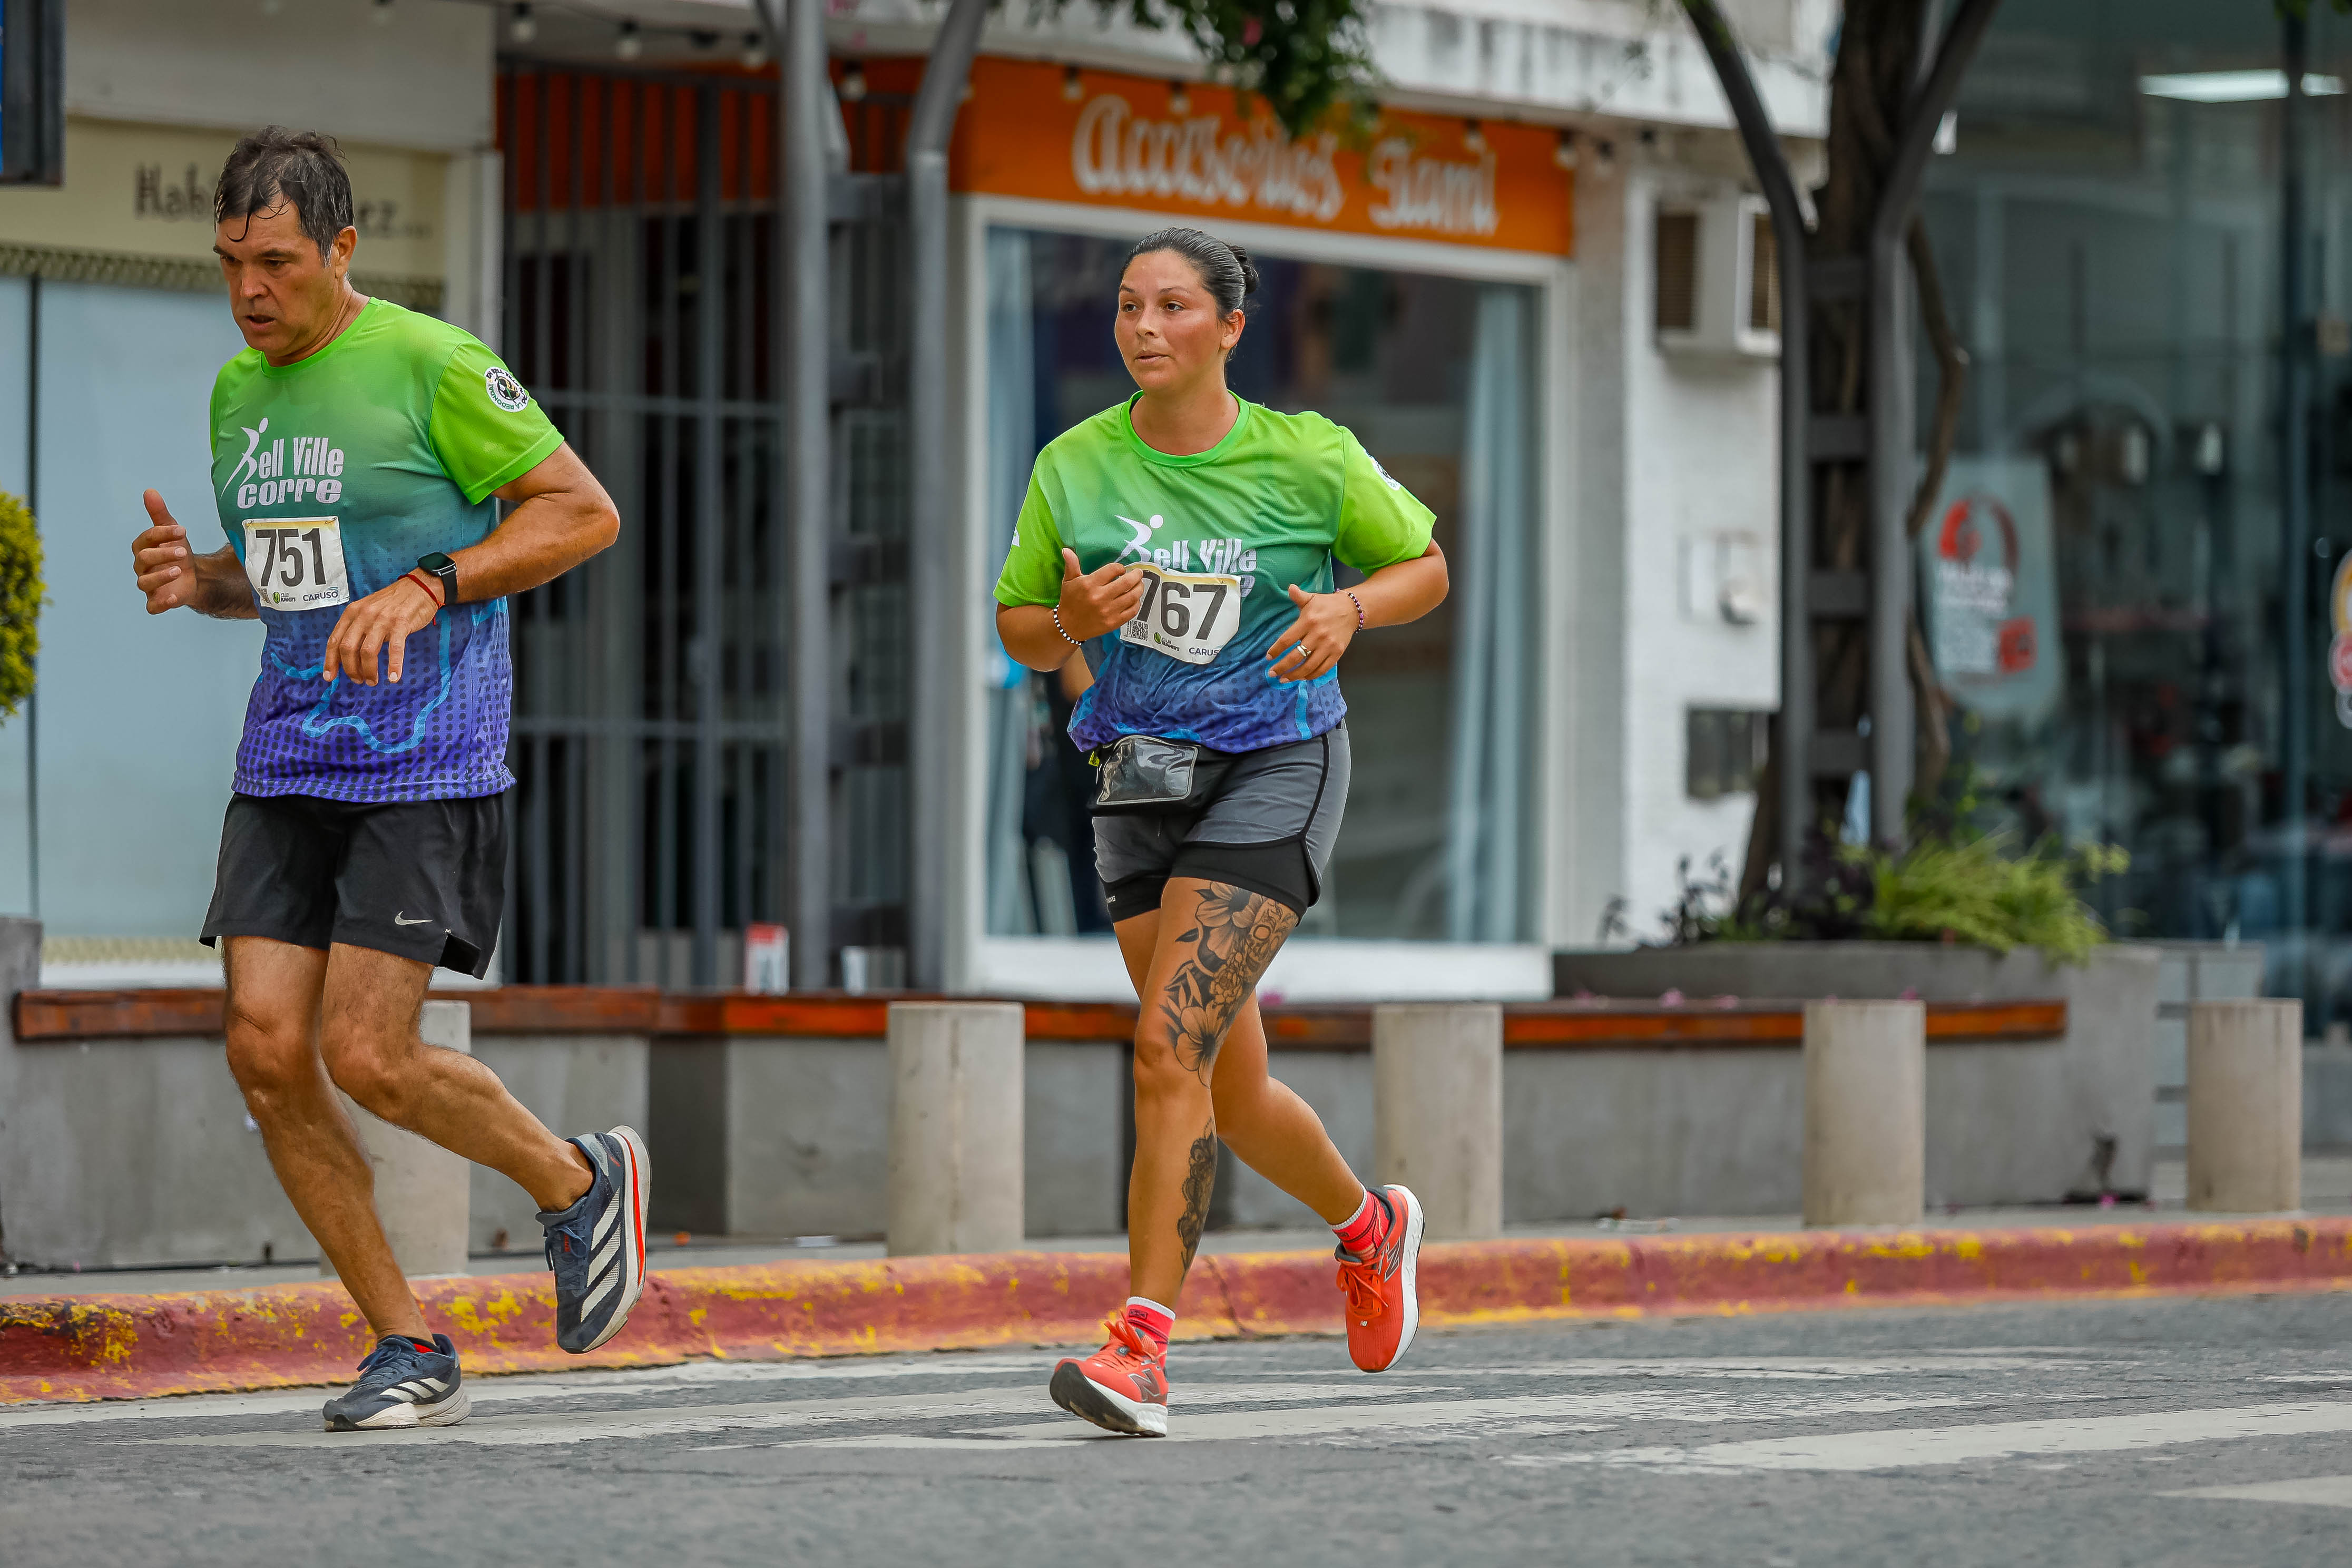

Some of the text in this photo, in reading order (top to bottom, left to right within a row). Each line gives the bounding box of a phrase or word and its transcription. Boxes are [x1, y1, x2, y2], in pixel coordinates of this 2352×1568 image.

[293, 437, 345, 477] Ville
[237, 477, 343, 509] corre
[255, 527, 327, 587] 751
[1199, 538, 1257, 574] Ville
[302, 591, 339, 602] CARUSO
[1136, 570, 1227, 641] 767
[1189, 647, 1220, 656] CARUS
